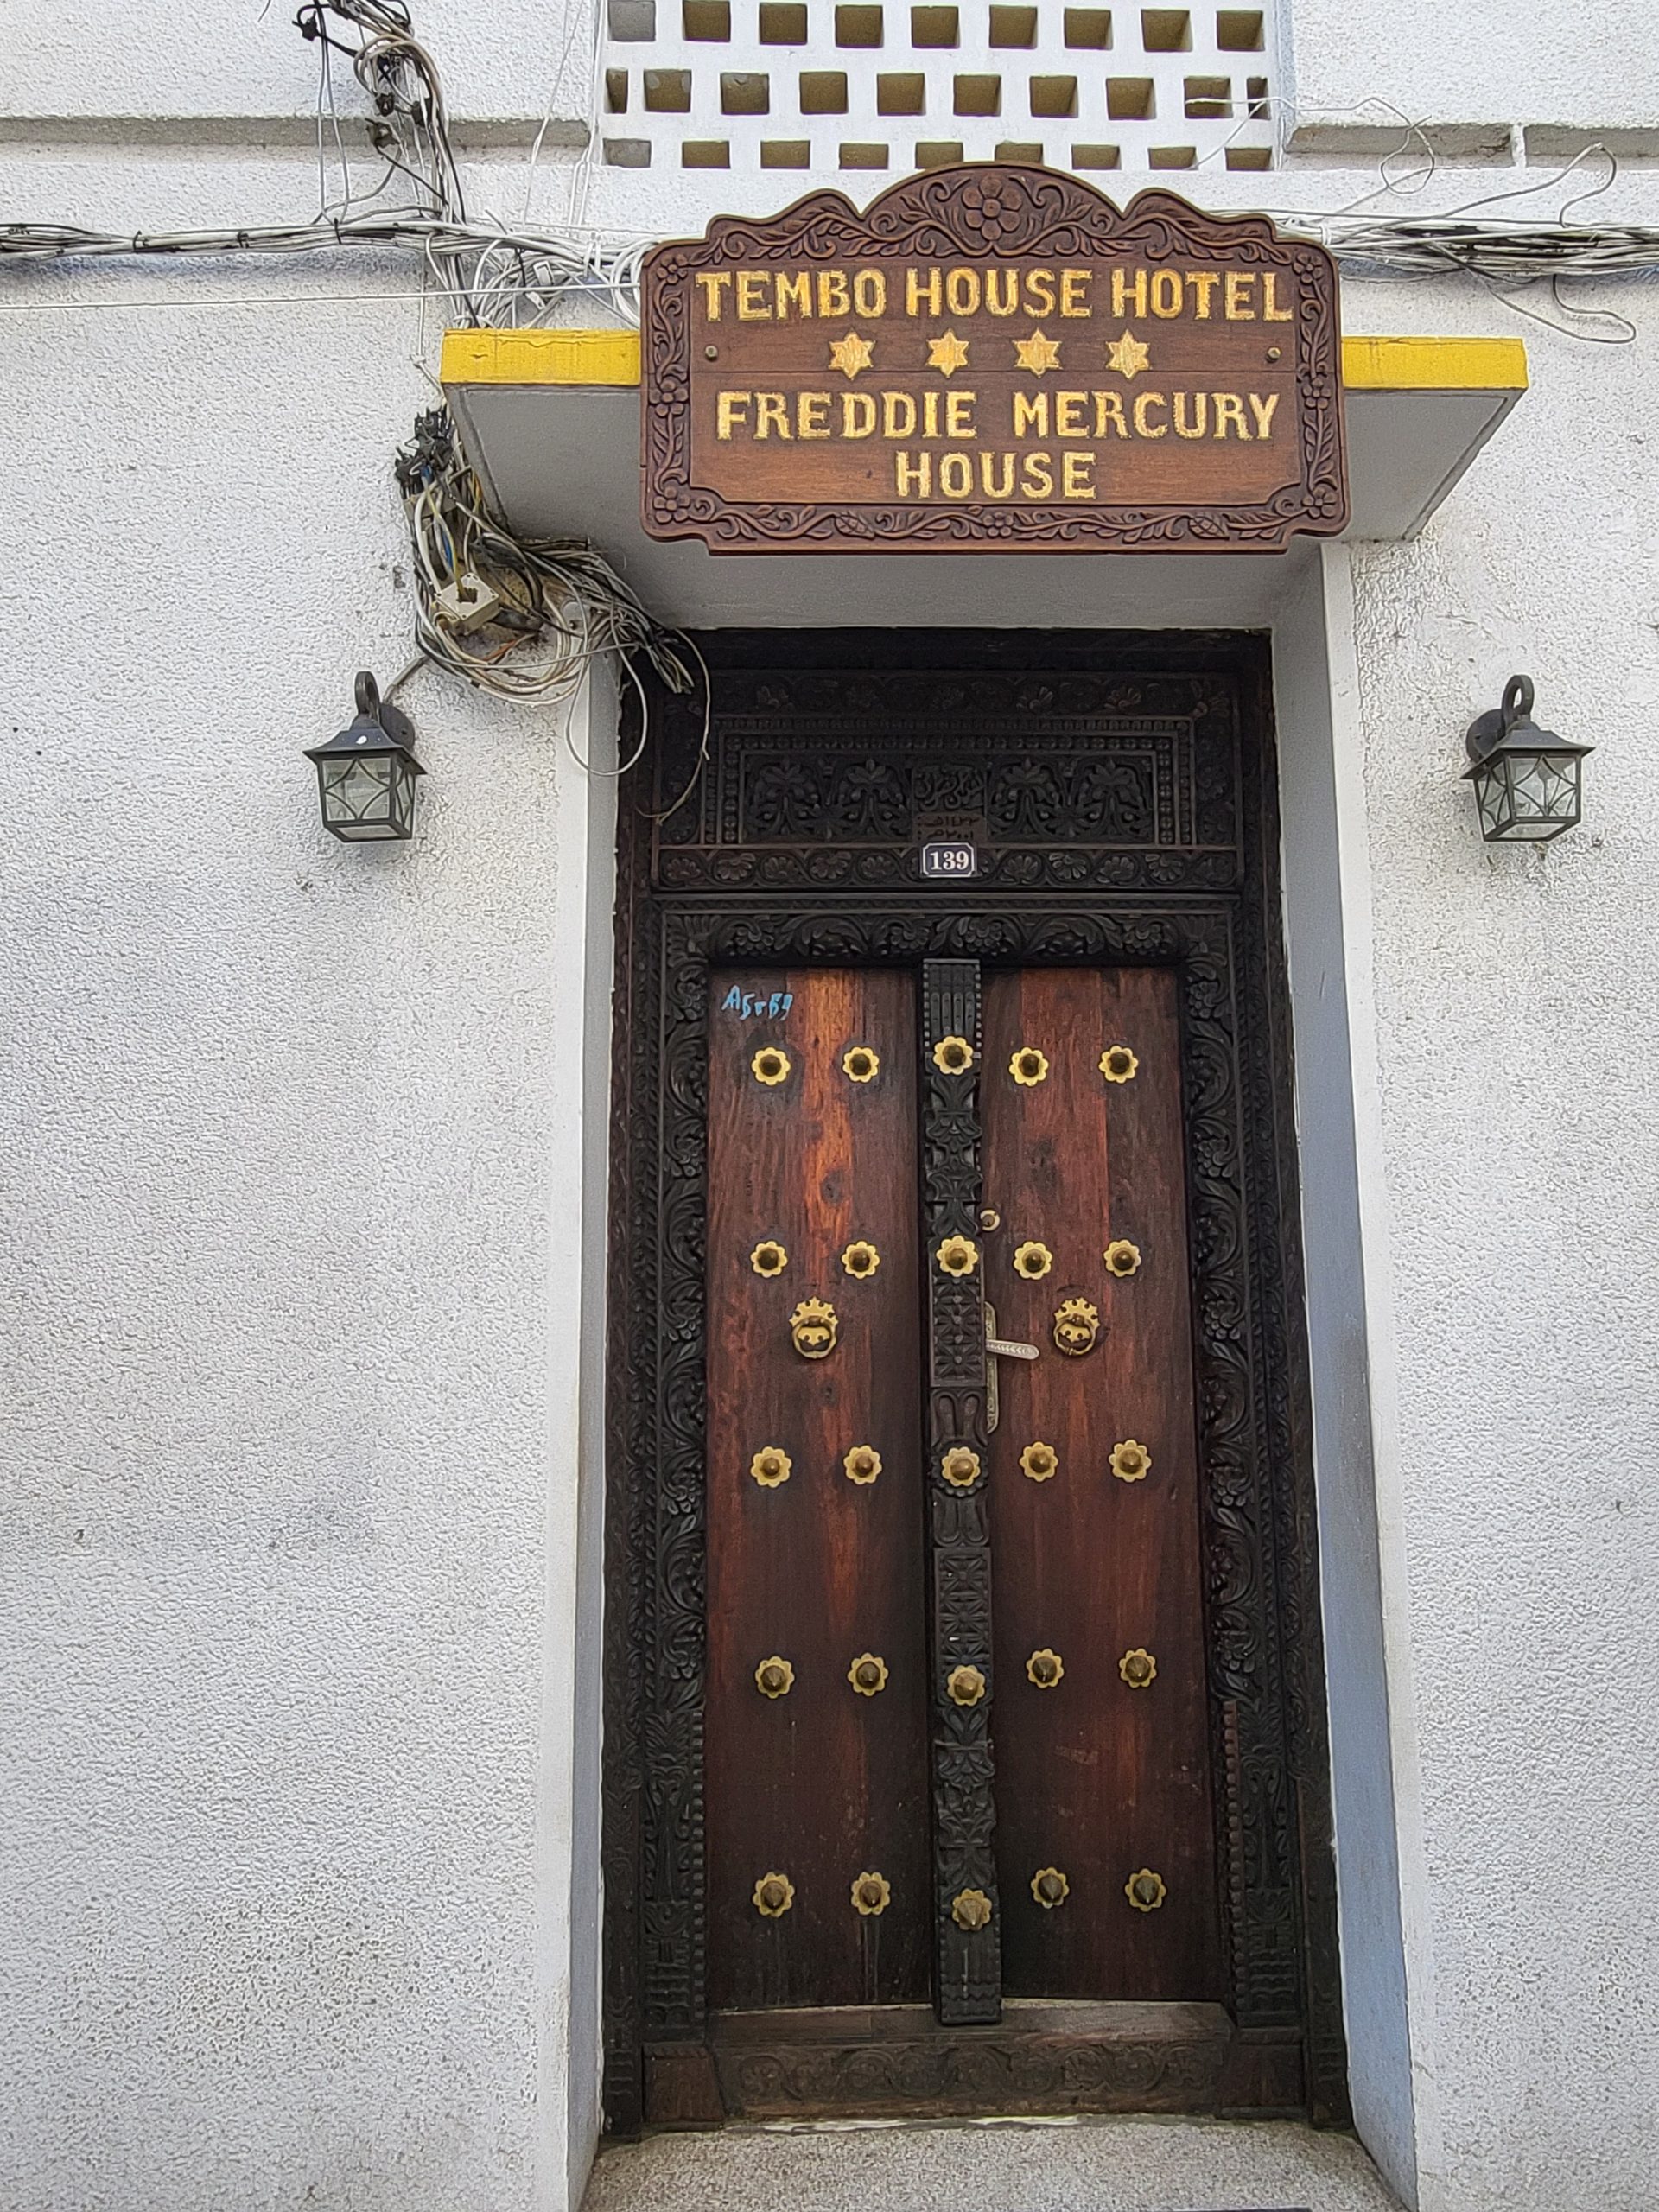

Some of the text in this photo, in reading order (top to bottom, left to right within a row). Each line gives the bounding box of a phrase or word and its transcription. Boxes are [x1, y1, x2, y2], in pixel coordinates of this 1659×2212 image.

[696, 266, 1295, 322] TEMBO HOUSE HOTEL
[716, 391, 1281, 442] FREDDIE MERCURY
[895, 451, 1097, 499] HOUSE
[929, 850, 969, 870] 139
